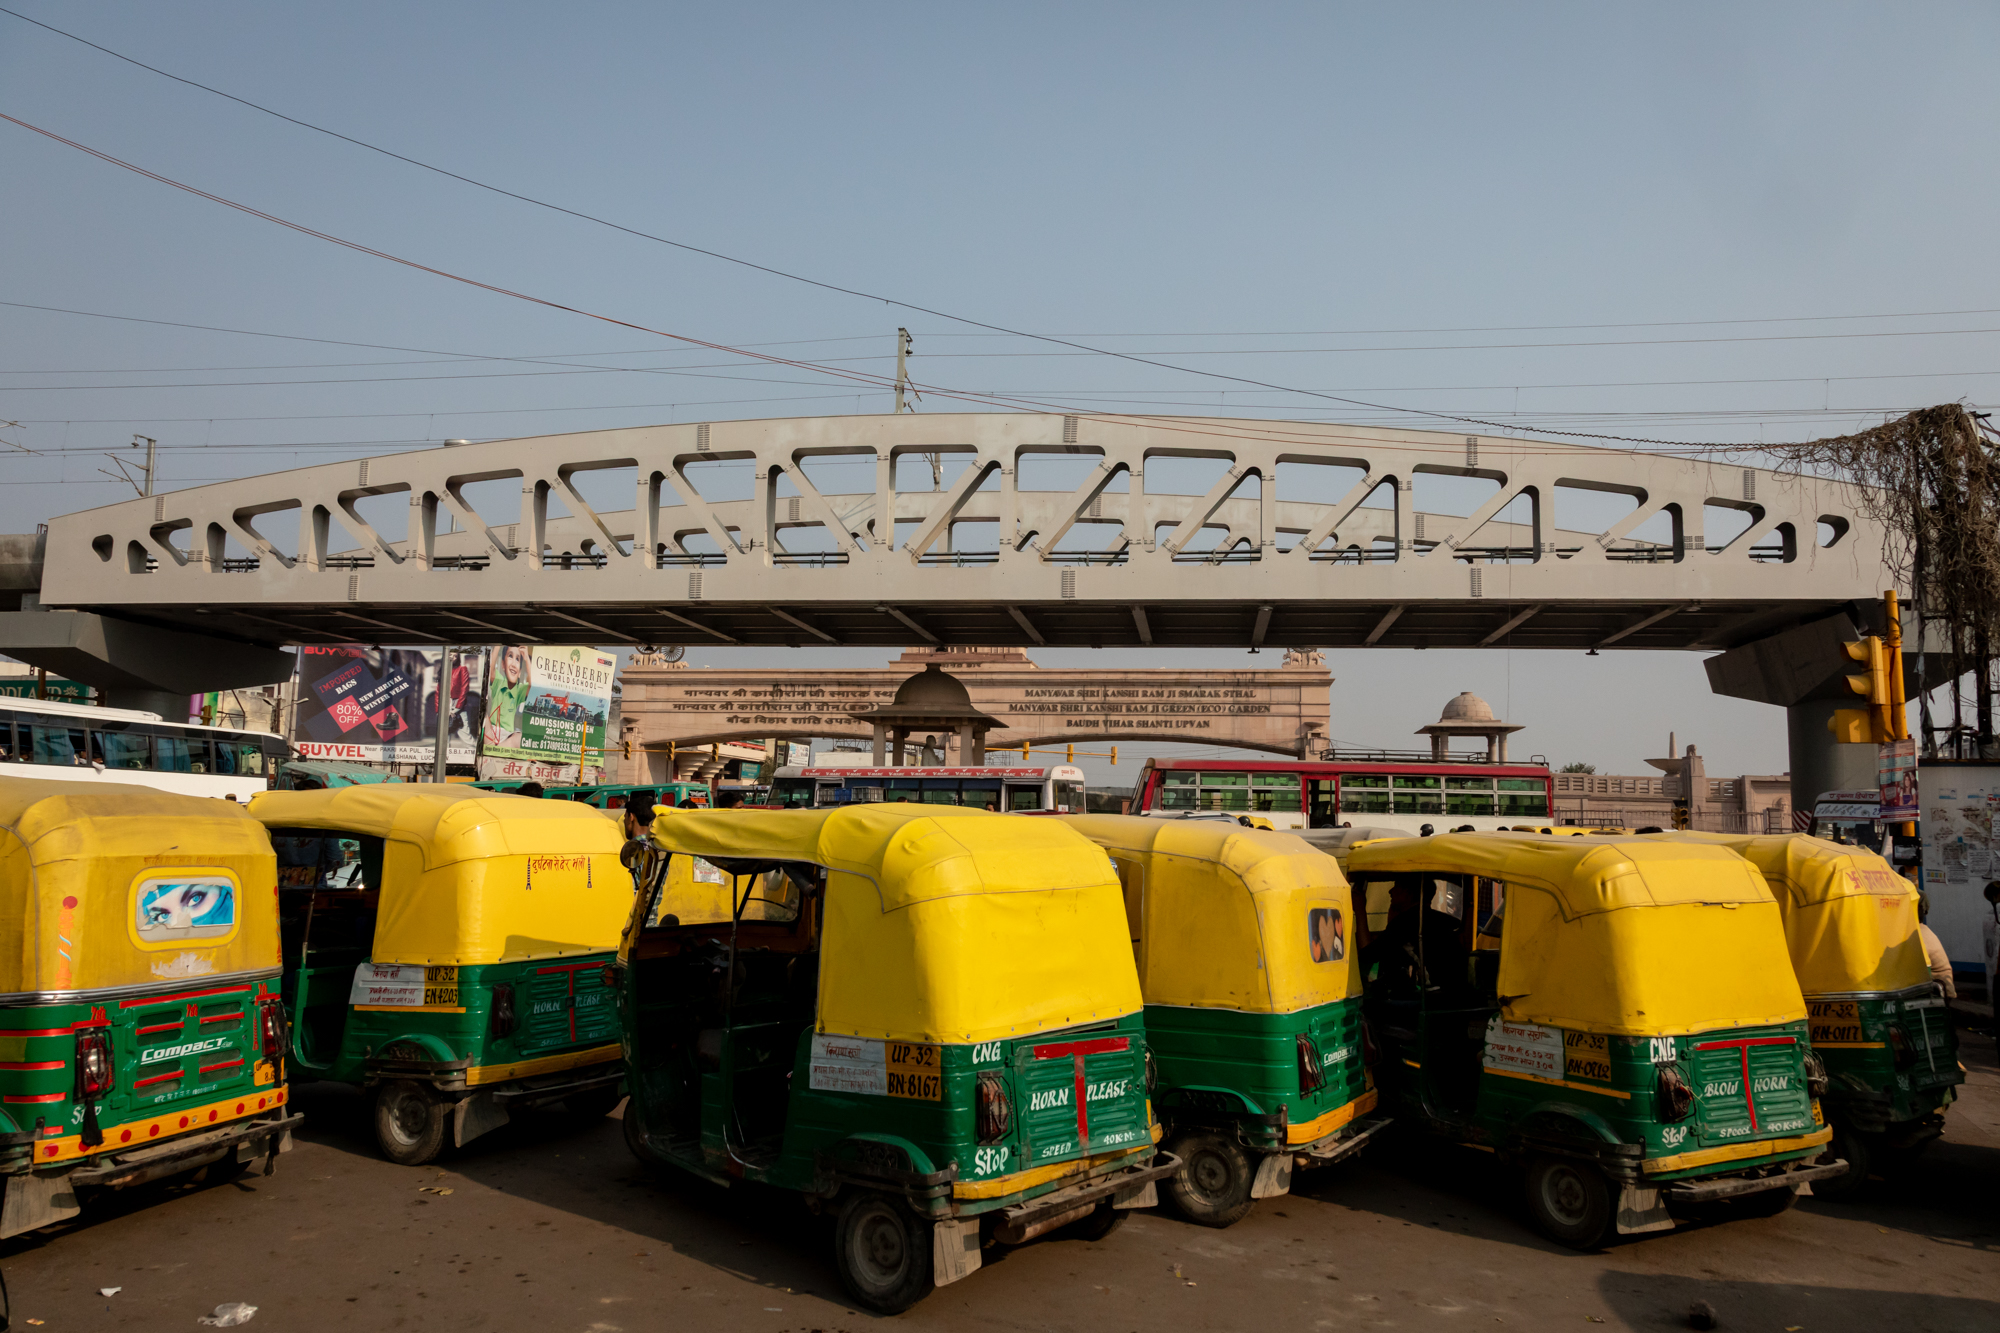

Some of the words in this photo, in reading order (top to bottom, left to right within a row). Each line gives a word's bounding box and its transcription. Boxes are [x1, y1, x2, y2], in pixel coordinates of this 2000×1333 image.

[536, 656, 610, 685] GREENBERRY
[319, 665, 362, 694] IMPORTED
[335, 679, 358, 695] BAGS
[547, 673, 571, 684] WORLD
[572, 677, 597, 690] SCHOOL
[0, 686, 62, 702] DLAD
[359, 691, 374, 704] NEW
[374, 675, 404, 695] ARRIVAL
[363, 694, 391, 711] WINTER
[389, 682, 410, 698] WEAR
[732, 688, 747, 697] श्री
[1025, 689, 1075, 698] MANYAVAR
[1077, 689, 1100, 698] SHRI
[1102, 689, 1139, 698] KANSHI
[1141, 689, 1164, 698] RAM
[1166, 690, 1176, 698] JI
[1178, 690, 1221, 698] SMARAK
[1222, 690, 1256, 698] STHAL
[336, 704, 362, 716] 80%
[673, 703, 716, 711] मान्यवर
[719, 702, 734, 711] श्री
[1008, 704, 1058, 713] MANYAVAR
[1060, 704, 1083, 713] SHRI
[1086, 704, 1123, 713] KANSHI
[1125, 704, 1148, 713] RAM
[1150, 704, 1160, 713] JI
[1162, 704, 1195, 713] GREEN
[1228, 704, 1271, 713] GARDEN
[339, 715, 359, 724] OFF
[530, 717, 575, 731] ADMISSIONS
[1066, 719, 1099, 728] BAUDH
[1102, 719, 1134, 728] VIHAR
[1136, 719, 1173, 728] SHANTI
[1175, 719, 1210, 728] UPVAN
[546, 728, 561, 736] 2017
[564, 730, 579, 739] 2018
[299, 743, 366, 758] BUYVEL
[521, 737, 532, 748] Call
[503, 762, 524, 776] वीर
[428, 967, 455, 981] UP-32
[533, 1001, 561, 1014] HORN
[575, 994, 601, 1008] PLEASE
[1811, 1003, 1855, 1018] UP-32
[1566, 1033, 1605, 1050] UP-32
[892, 1045, 935, 1067] UP-32
[972, 1042, 1001, 1065] CNG
[1650, 1037, 1677, 1063] CNG
[888, 1072, 940, 1098] BN-8167
[1704, 1081, 1739, 1097] BLOW
[1754, 1076, 1788, 1093] HORN
[1031, 1087, 1069, 1111] HORN
[1087, 1079, 1129, 1102] PLEASE
[1042, 1142, 1072, 1158] SPEED
